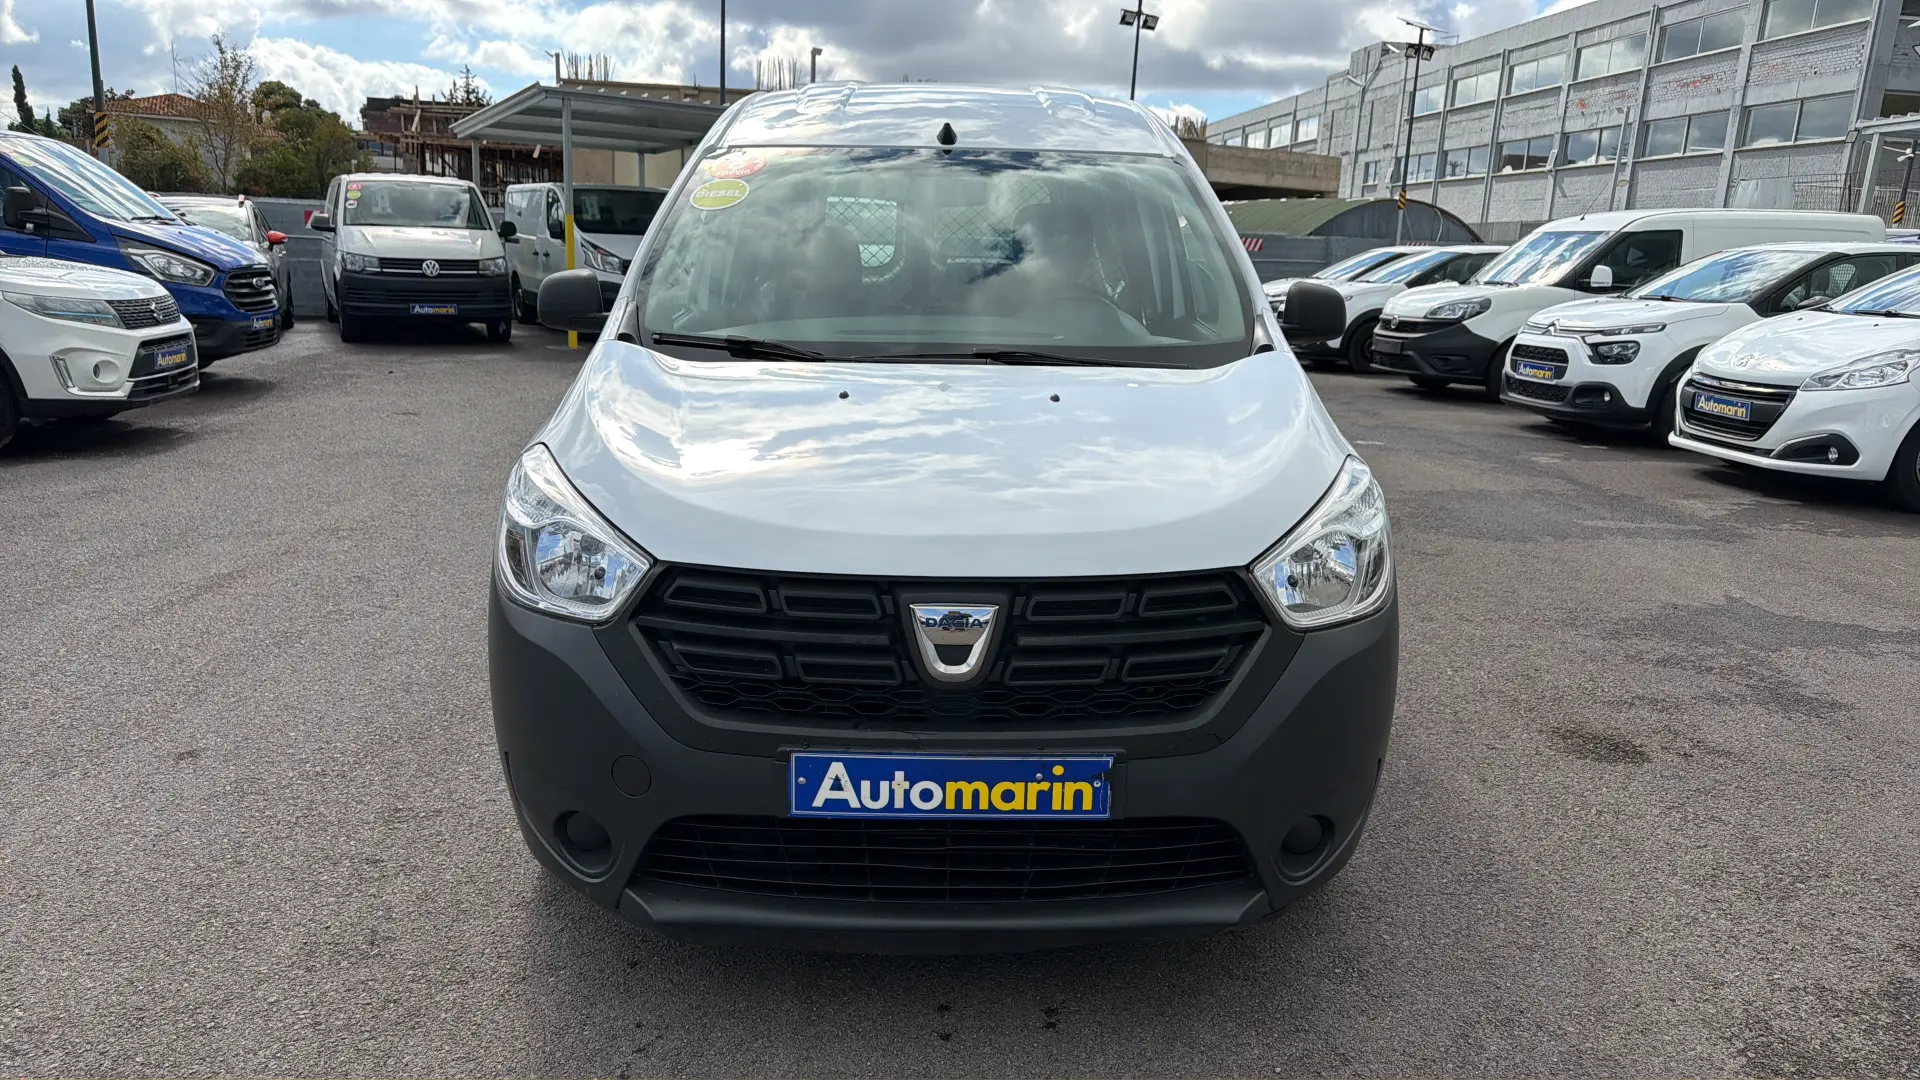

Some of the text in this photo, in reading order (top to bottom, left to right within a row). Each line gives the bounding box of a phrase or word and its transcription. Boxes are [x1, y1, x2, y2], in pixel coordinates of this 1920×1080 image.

[696, 189, 742, 198] DIESEL
[1518, 363, 1552, 379] Automarin
[1698, 395, 1747, 418] Automarin
[925, 617, 984, 629] DACIA
[811, 761, 1093, 811] Automarin
